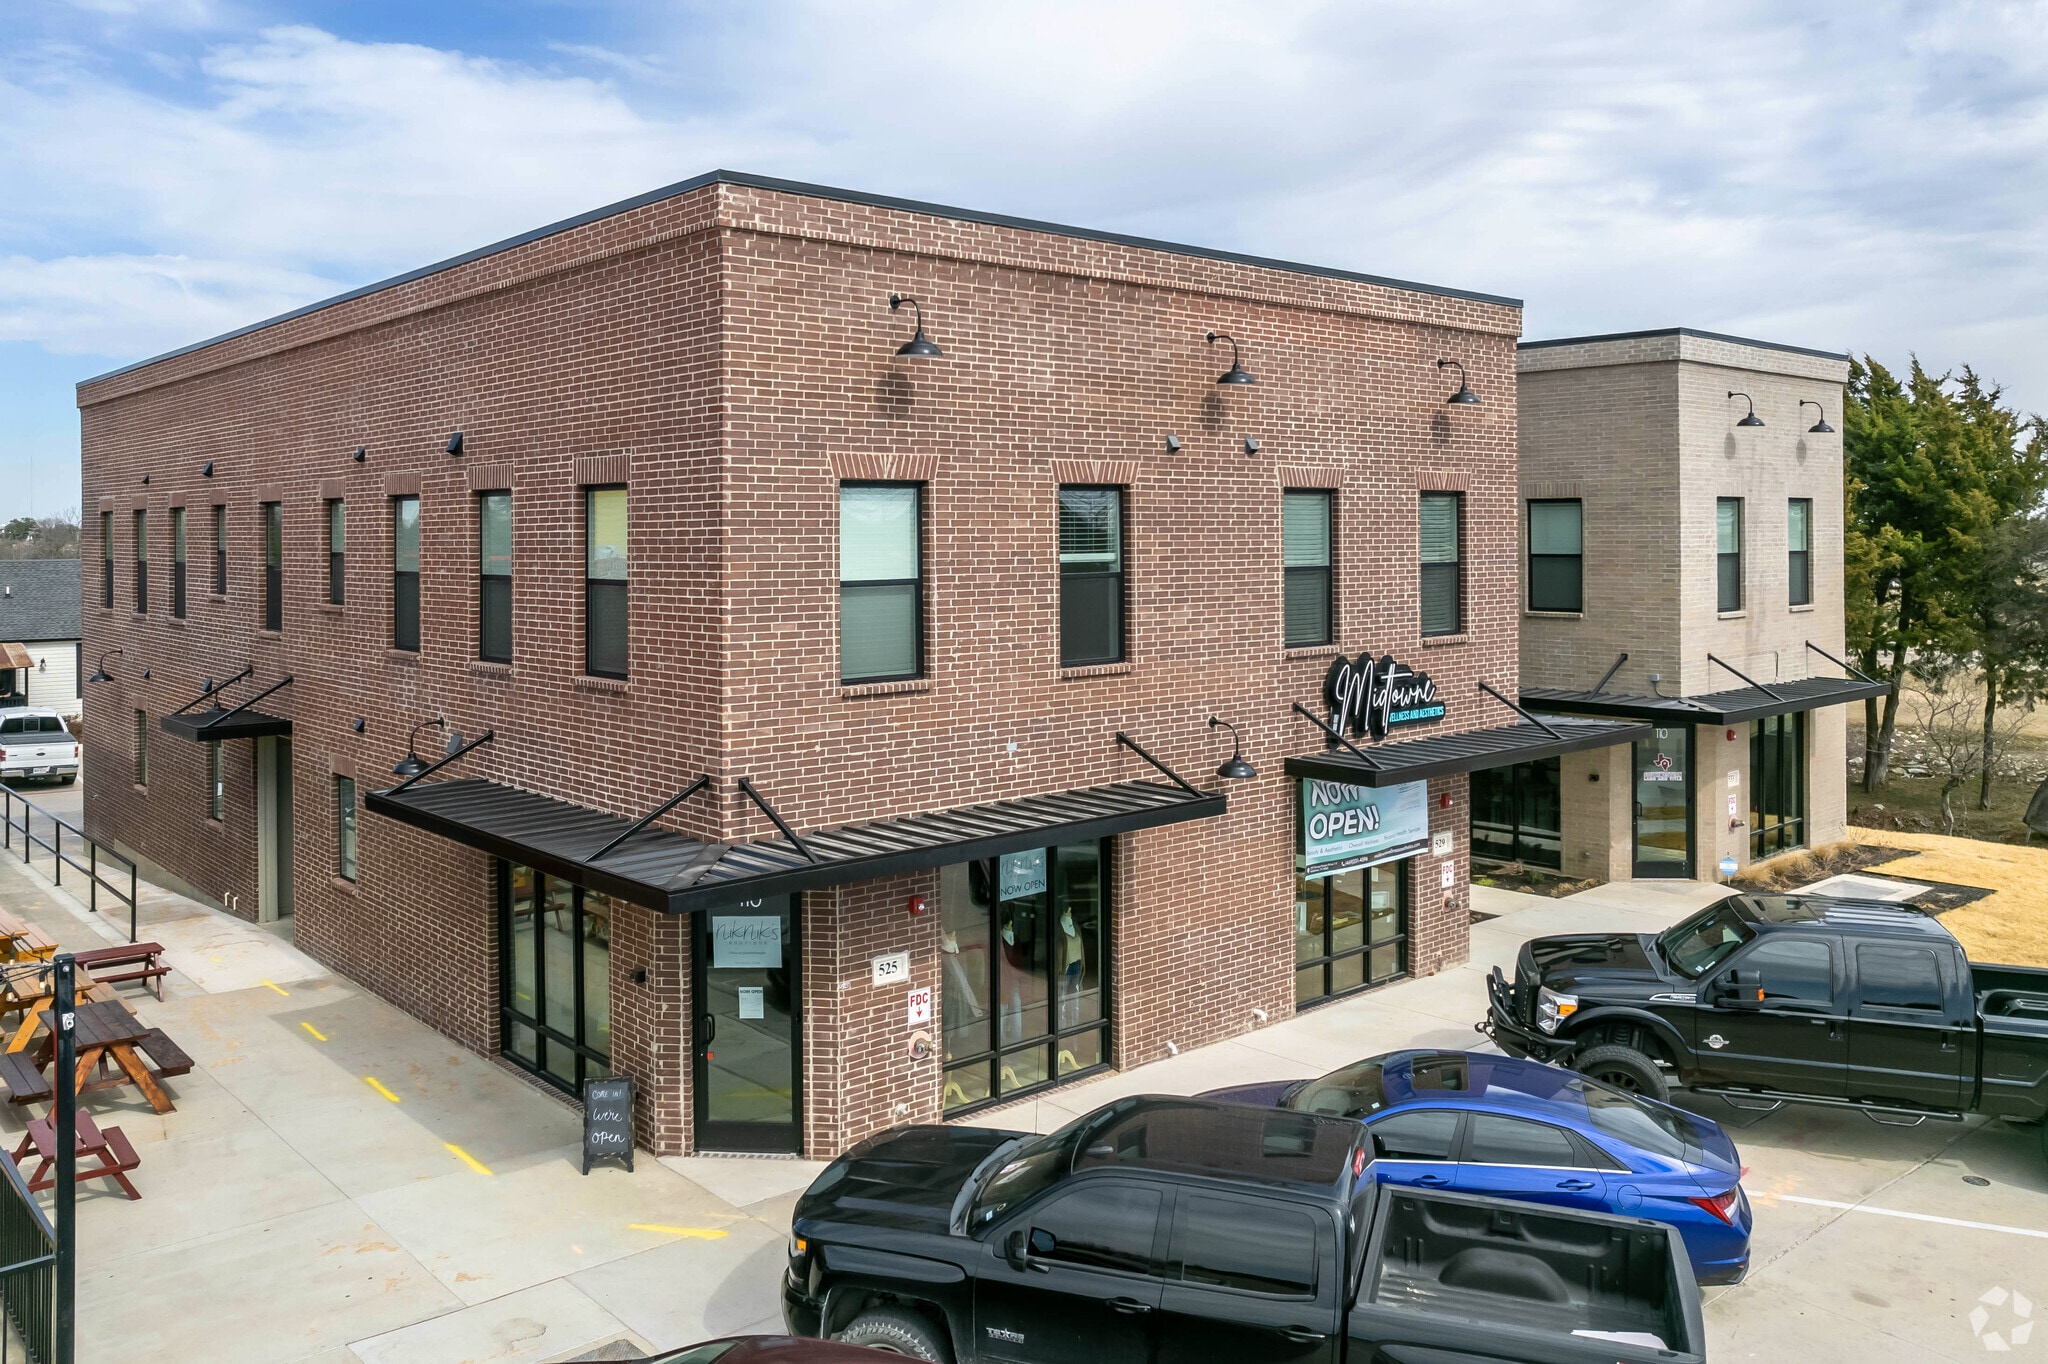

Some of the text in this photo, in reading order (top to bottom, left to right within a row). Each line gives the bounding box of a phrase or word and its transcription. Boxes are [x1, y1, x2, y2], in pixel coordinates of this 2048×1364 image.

[1336, 660, 1436, 737] Midtowne
[1410, 710, 1419, 719] AND
[1656, 728, 1668, 739] 110
[1311, 781, 1359, 807] NOW
[1309, 805, 1380, 840] OPEN!
[1435, 838, 1446, 848] 529
[1443, 864, 1453, 874] FDC
[1001, 878, 1045, 896] NOW OPEN
[878, 961, 898, 976] 525
[910, 992, 929, 1007] FDC
